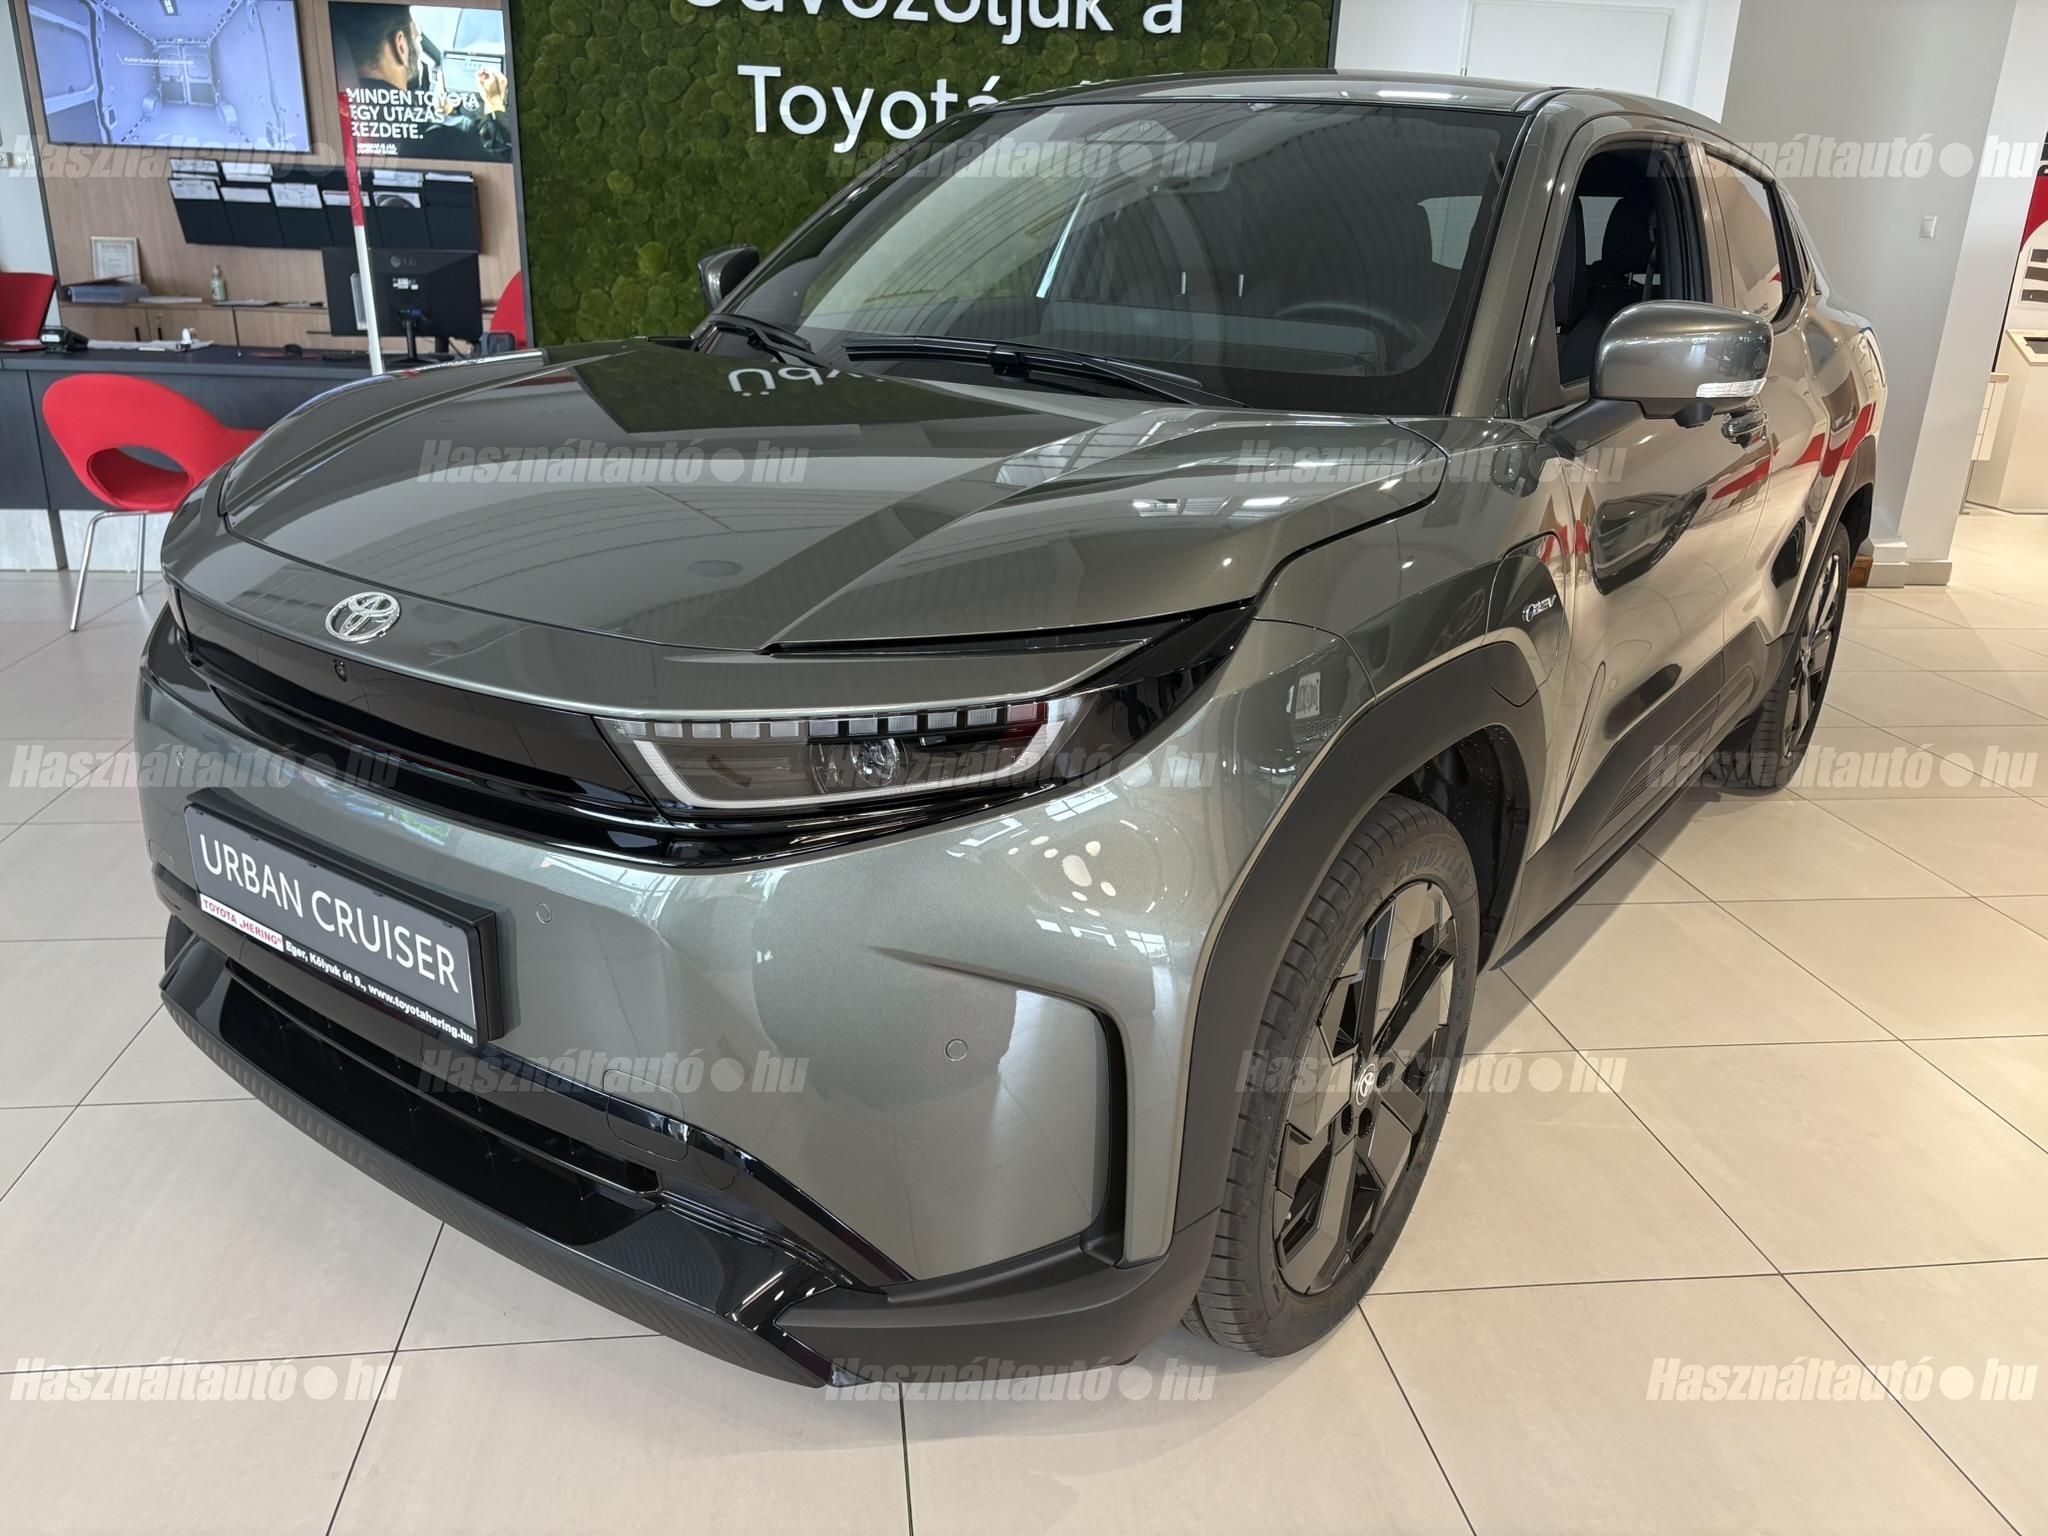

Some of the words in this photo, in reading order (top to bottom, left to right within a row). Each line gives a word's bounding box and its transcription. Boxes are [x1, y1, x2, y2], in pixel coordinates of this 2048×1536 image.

[346, 88, 411, 106] MINDEN
[383, 105, 445, 123] UTAZÁS
[199, 833, 304, 919] URBAN
[311, 890, 460, 994] CRUISER
[202, 898, 238, 925] TOYOTA
[368, 985, 474, 1045] www.toyotahering.hu
